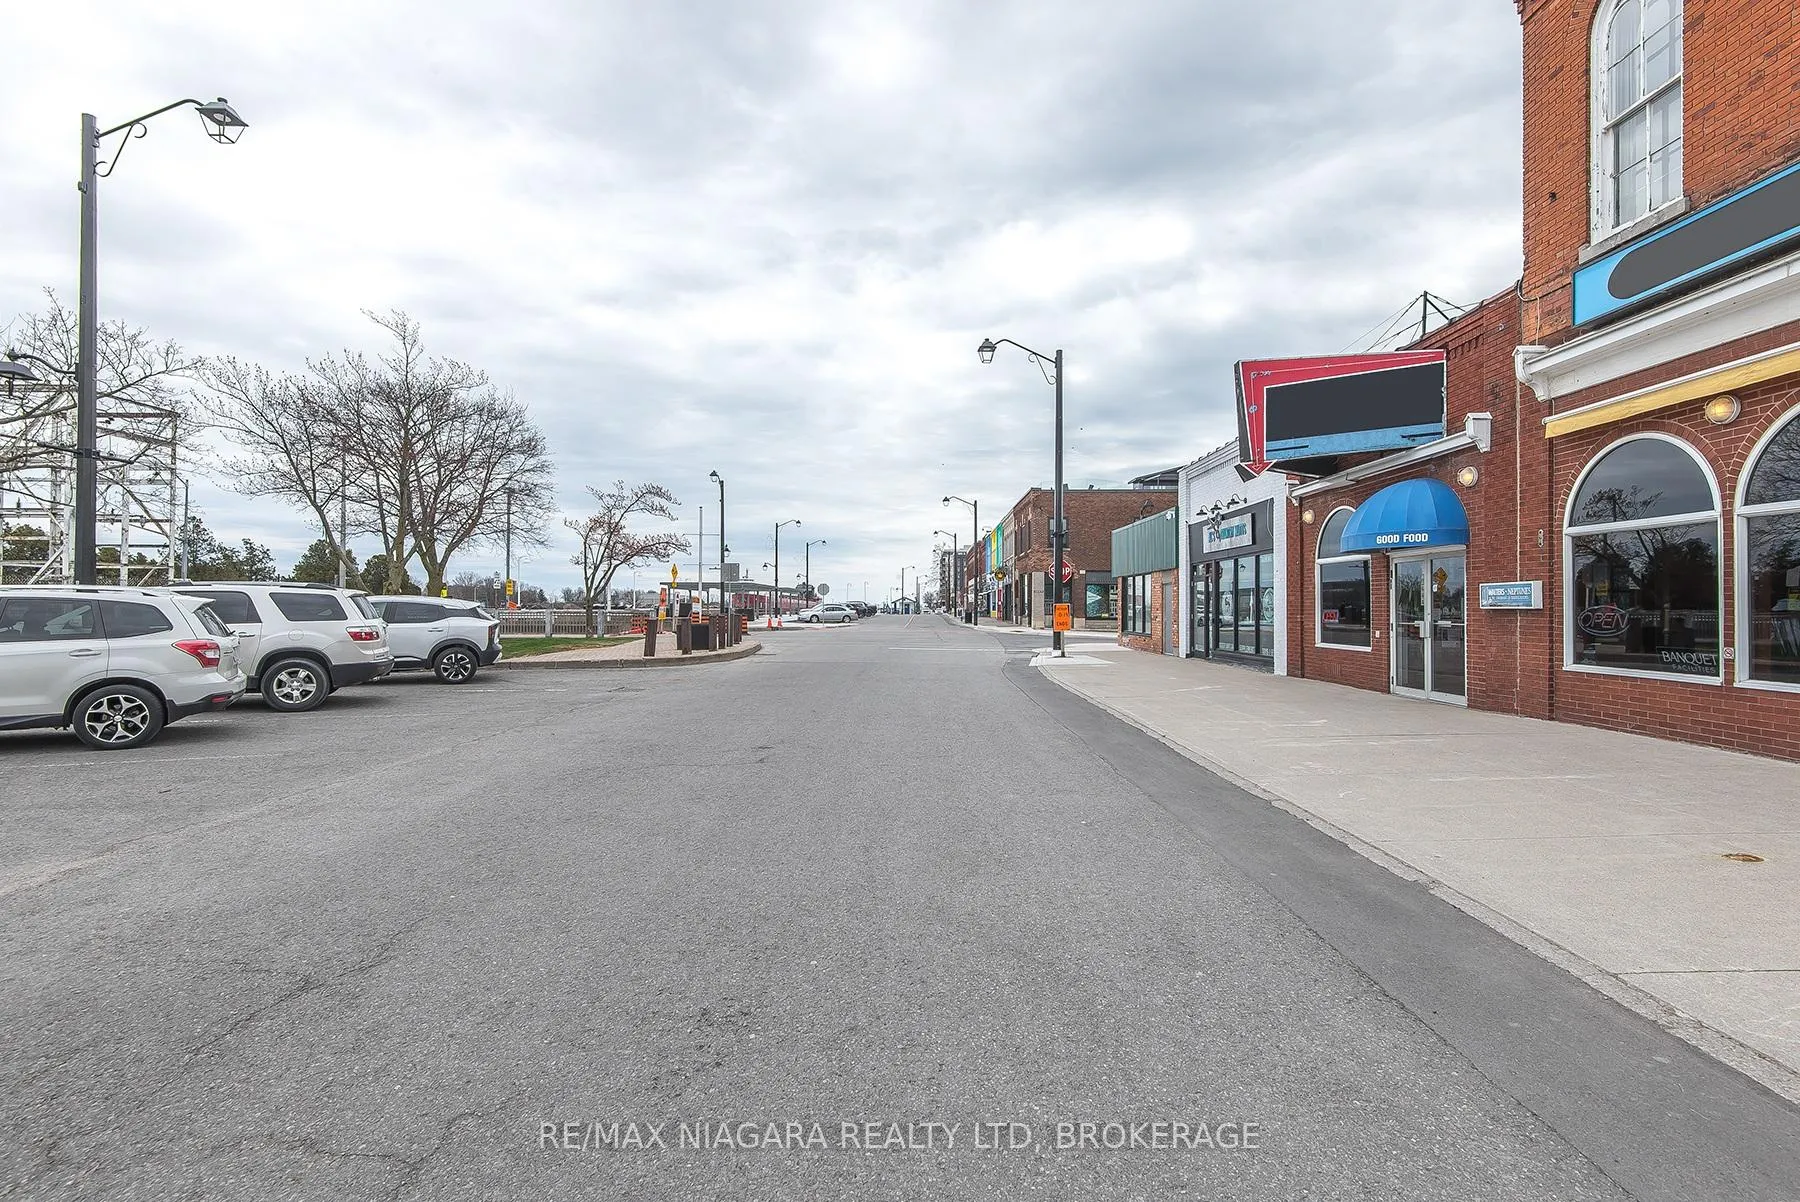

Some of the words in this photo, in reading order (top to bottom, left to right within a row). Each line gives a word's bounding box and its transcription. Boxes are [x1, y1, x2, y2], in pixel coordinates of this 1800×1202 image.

[1376, 534, 1400, 544] GOOD
[1403, 533, 1429, 543] FOOD
[1580, 611, 1629, 629] OPEN
[1661, 650, 1718, 666] BANQUET
[1671, 663, 1716, 674] FACILITIES
